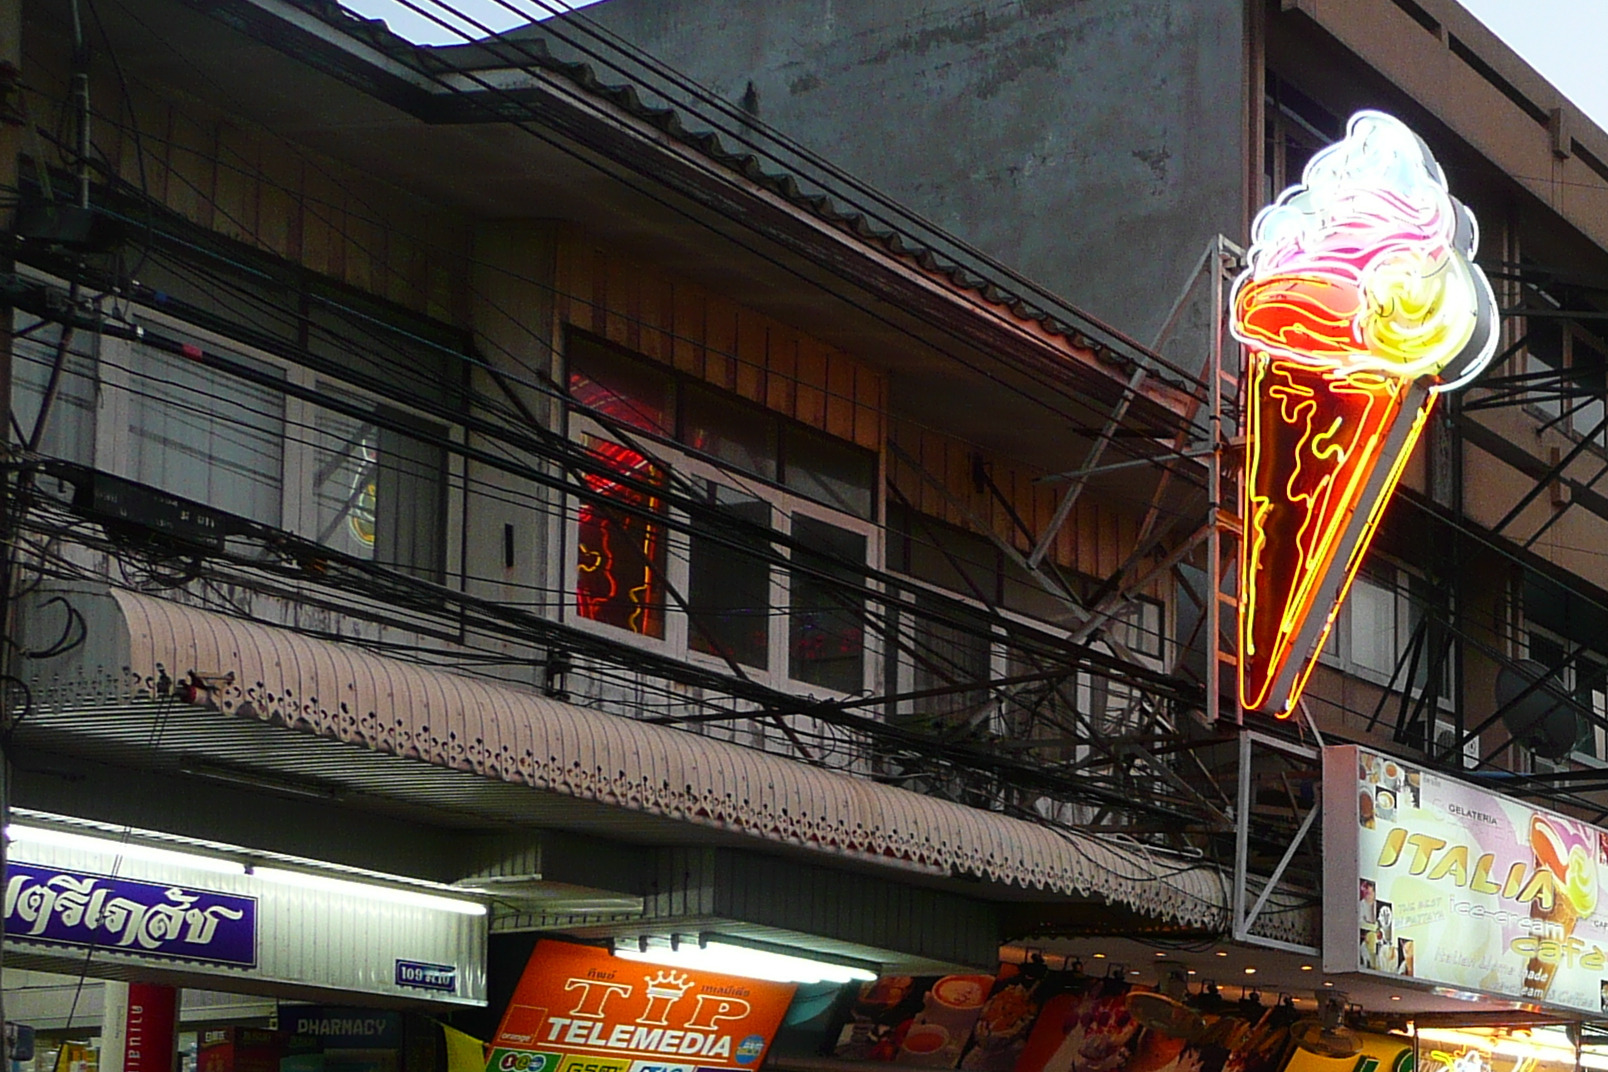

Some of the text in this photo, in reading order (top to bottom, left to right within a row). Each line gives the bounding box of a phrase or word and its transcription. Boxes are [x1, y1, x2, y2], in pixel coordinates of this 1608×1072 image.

[1449, 803, 1498, 825] GELATERIA
[1377, 828, 1554, 910] ITALIA
[1450, 894, 1565, 941] ice-cream
[401, 966, 423, 981] 109
[564, 977, 751, 1031] TIP
[501, 1033, 532, 1043] orange
[547, 1017, 731, 1058] TELEMEDIA
